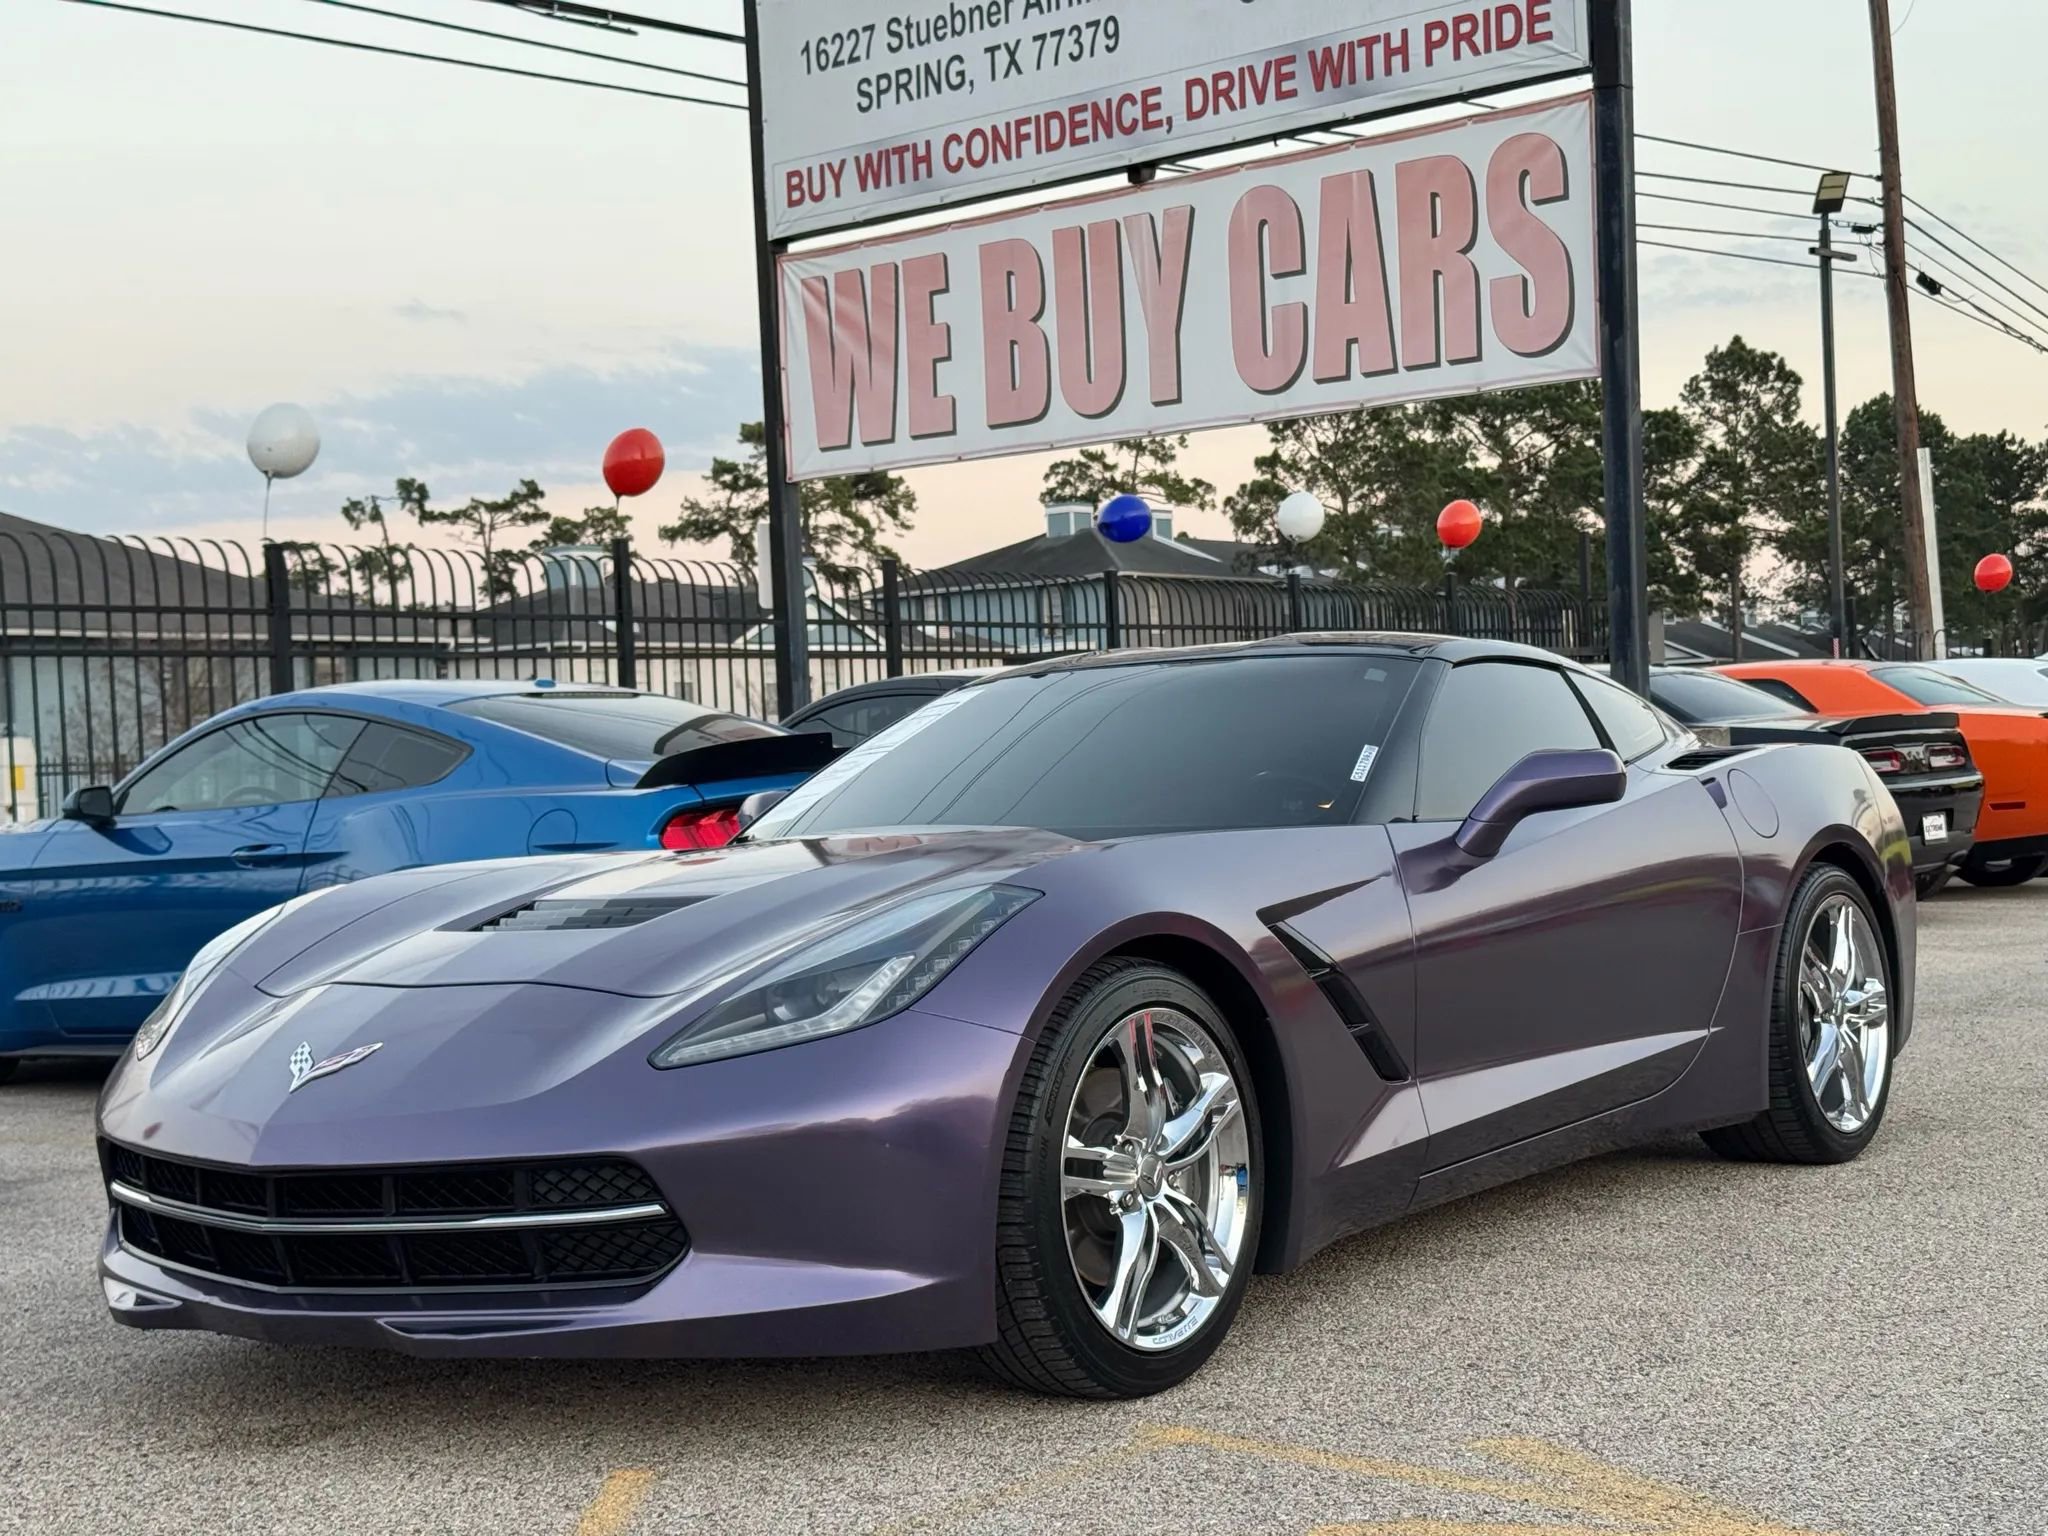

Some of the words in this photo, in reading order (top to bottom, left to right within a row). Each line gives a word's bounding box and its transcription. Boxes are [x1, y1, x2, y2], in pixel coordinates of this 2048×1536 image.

[786, 158, 847, 208] BUY
[854, 140, 933, 193] WITH
[942, 87, 1174, 174] CONFIDENCE,
[1185, 54, 1298, 121] DRIVE
[1308, 28, 1410, 93] WITH
[1424, 0, 1554, 67] PRIDE
[800, 24, 876, 75] 16227
[886, 0, 1013, 53] Stuebner
[857, 54, 975, 113] SPRING,
[984, 39, 1023, 82] TX
[1032, 15, 1121, 72] 77379
[800, 251, 957, 450] WE
[979, 204, 1195, 429] BUY
[1227, 131, 1575, 394] CARS
